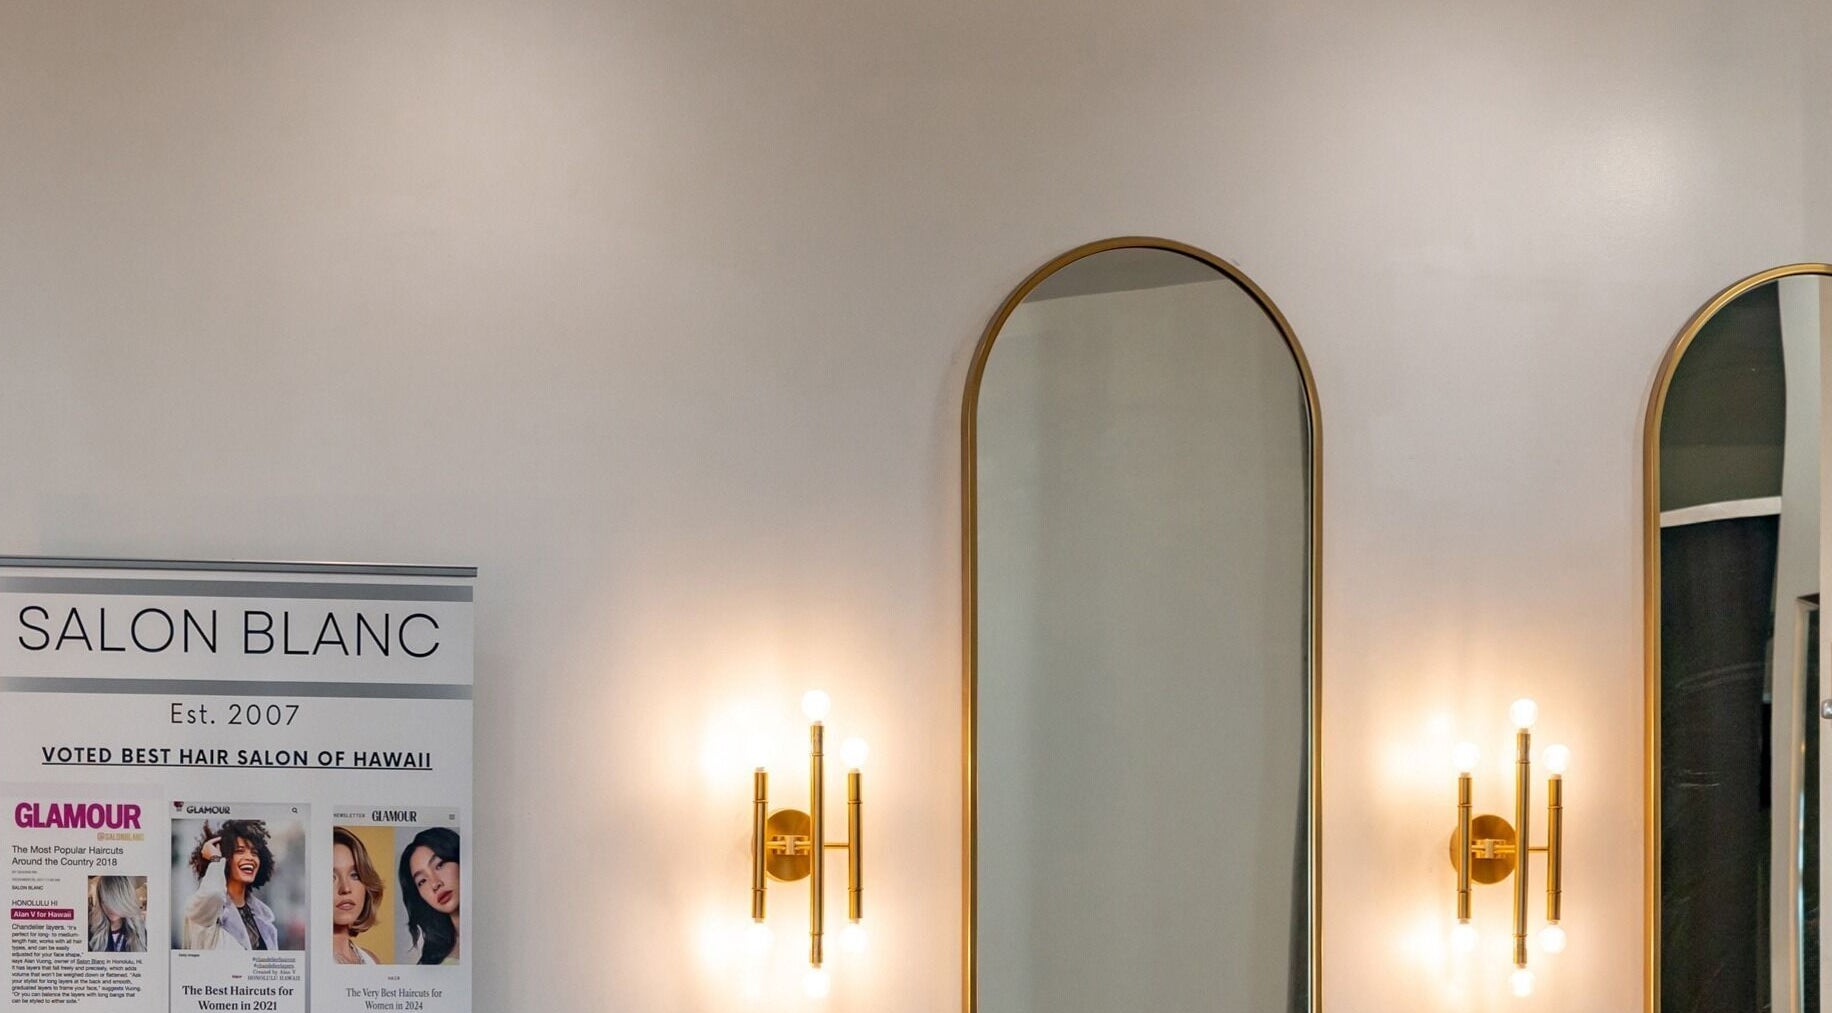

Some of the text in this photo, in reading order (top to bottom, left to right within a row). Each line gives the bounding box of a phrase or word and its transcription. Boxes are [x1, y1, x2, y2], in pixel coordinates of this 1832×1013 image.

[19, 606, 439, 657] SALON BLANC
[172, 703, 299, 725] Est. 2007
[42, 747, 430, 767] VOTED BEST HAIR SALON OF HAWAII
[14, 802, 141, 829] GLAMOUR
[187, 806, 230, 814] GLAMOUR
[372, 810, 417, 821] GLAMOUR
[12, 845, 123, 857] The Most Popular Haircuts
[45, 858, 58, 866] the
[61, 858, 94, 868] Country
[96, 858, 117, 866] 2018
[13, 910, 29, 918] Alan
[182, 986, 294, 996] The Best Haircuts for
[346, 988, 442, 999] The Very Best Haircuts for
[198, 1000, 277, 1011] Women in 2021
[365, 1001, 423, 1010] Women in 2024
